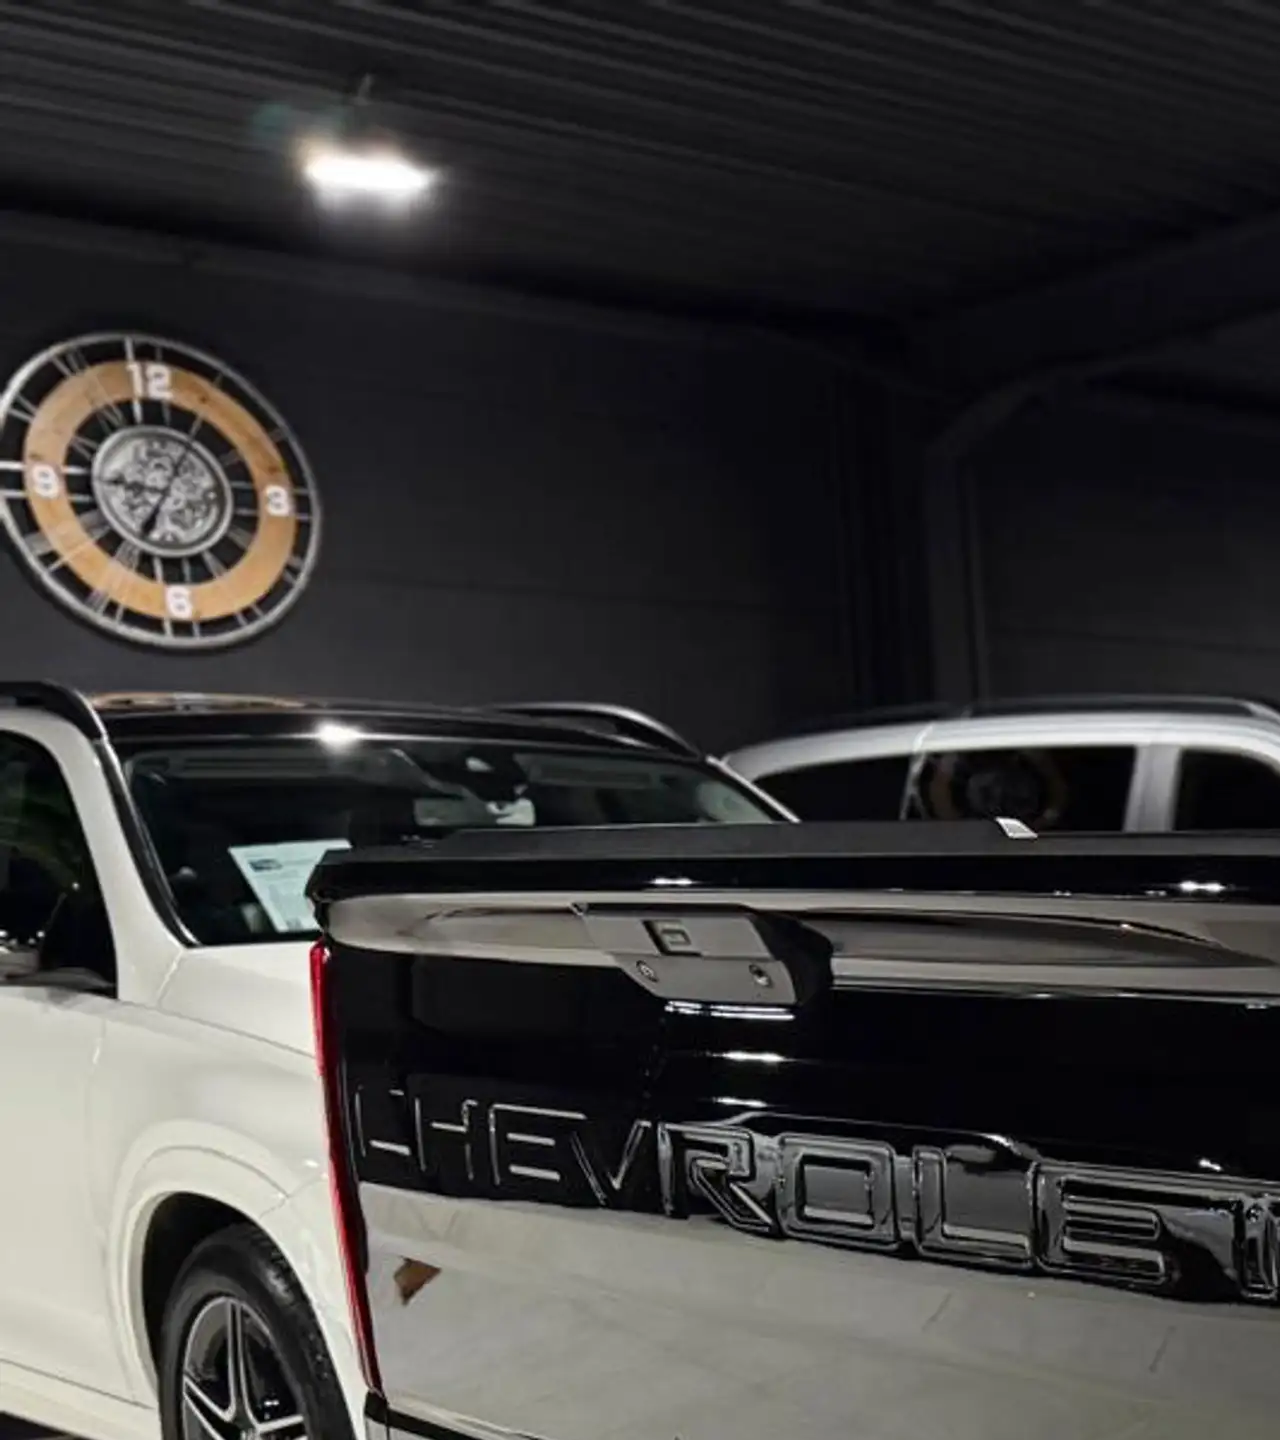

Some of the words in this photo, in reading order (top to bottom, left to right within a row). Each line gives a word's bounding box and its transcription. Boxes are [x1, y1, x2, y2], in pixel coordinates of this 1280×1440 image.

[127, 363, 174, 399] 12
[264, 484, 291, 517] 3
[164, 584, 194, 618] 6
